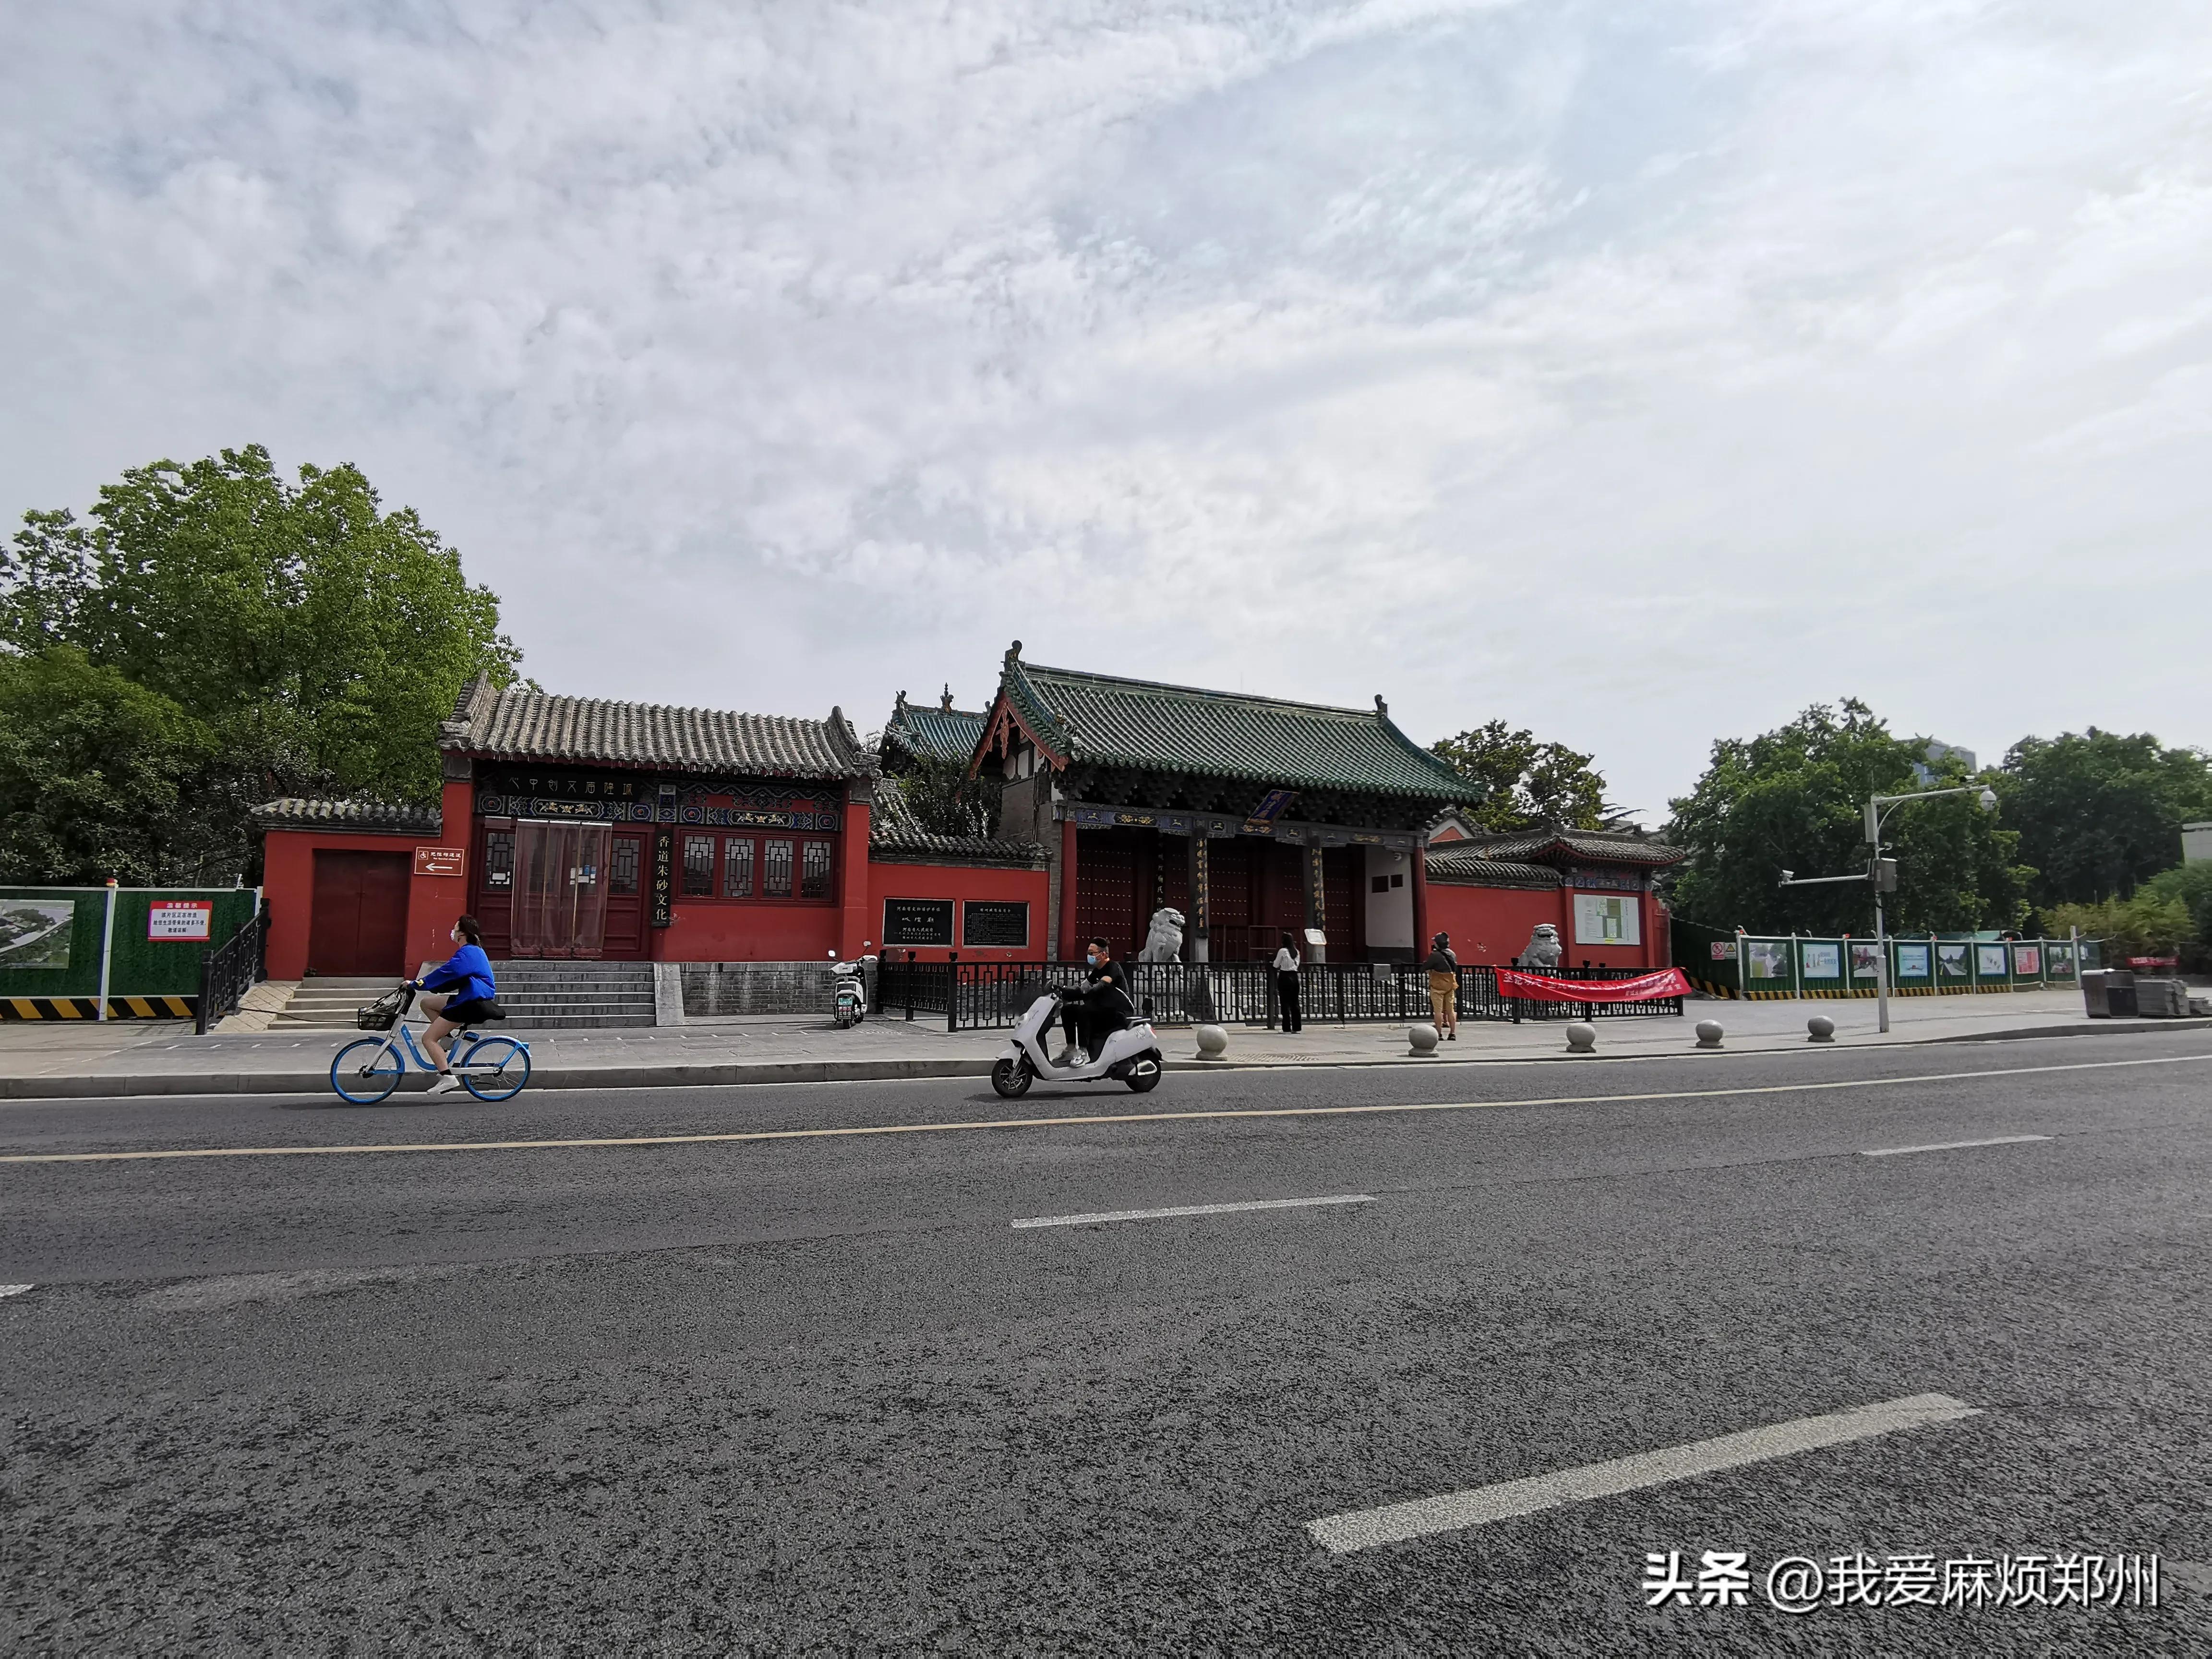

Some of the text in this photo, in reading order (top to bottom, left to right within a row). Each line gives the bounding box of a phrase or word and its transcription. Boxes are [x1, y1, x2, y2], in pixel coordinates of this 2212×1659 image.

[656, 836, 670, 920] 香道朱砂文化
